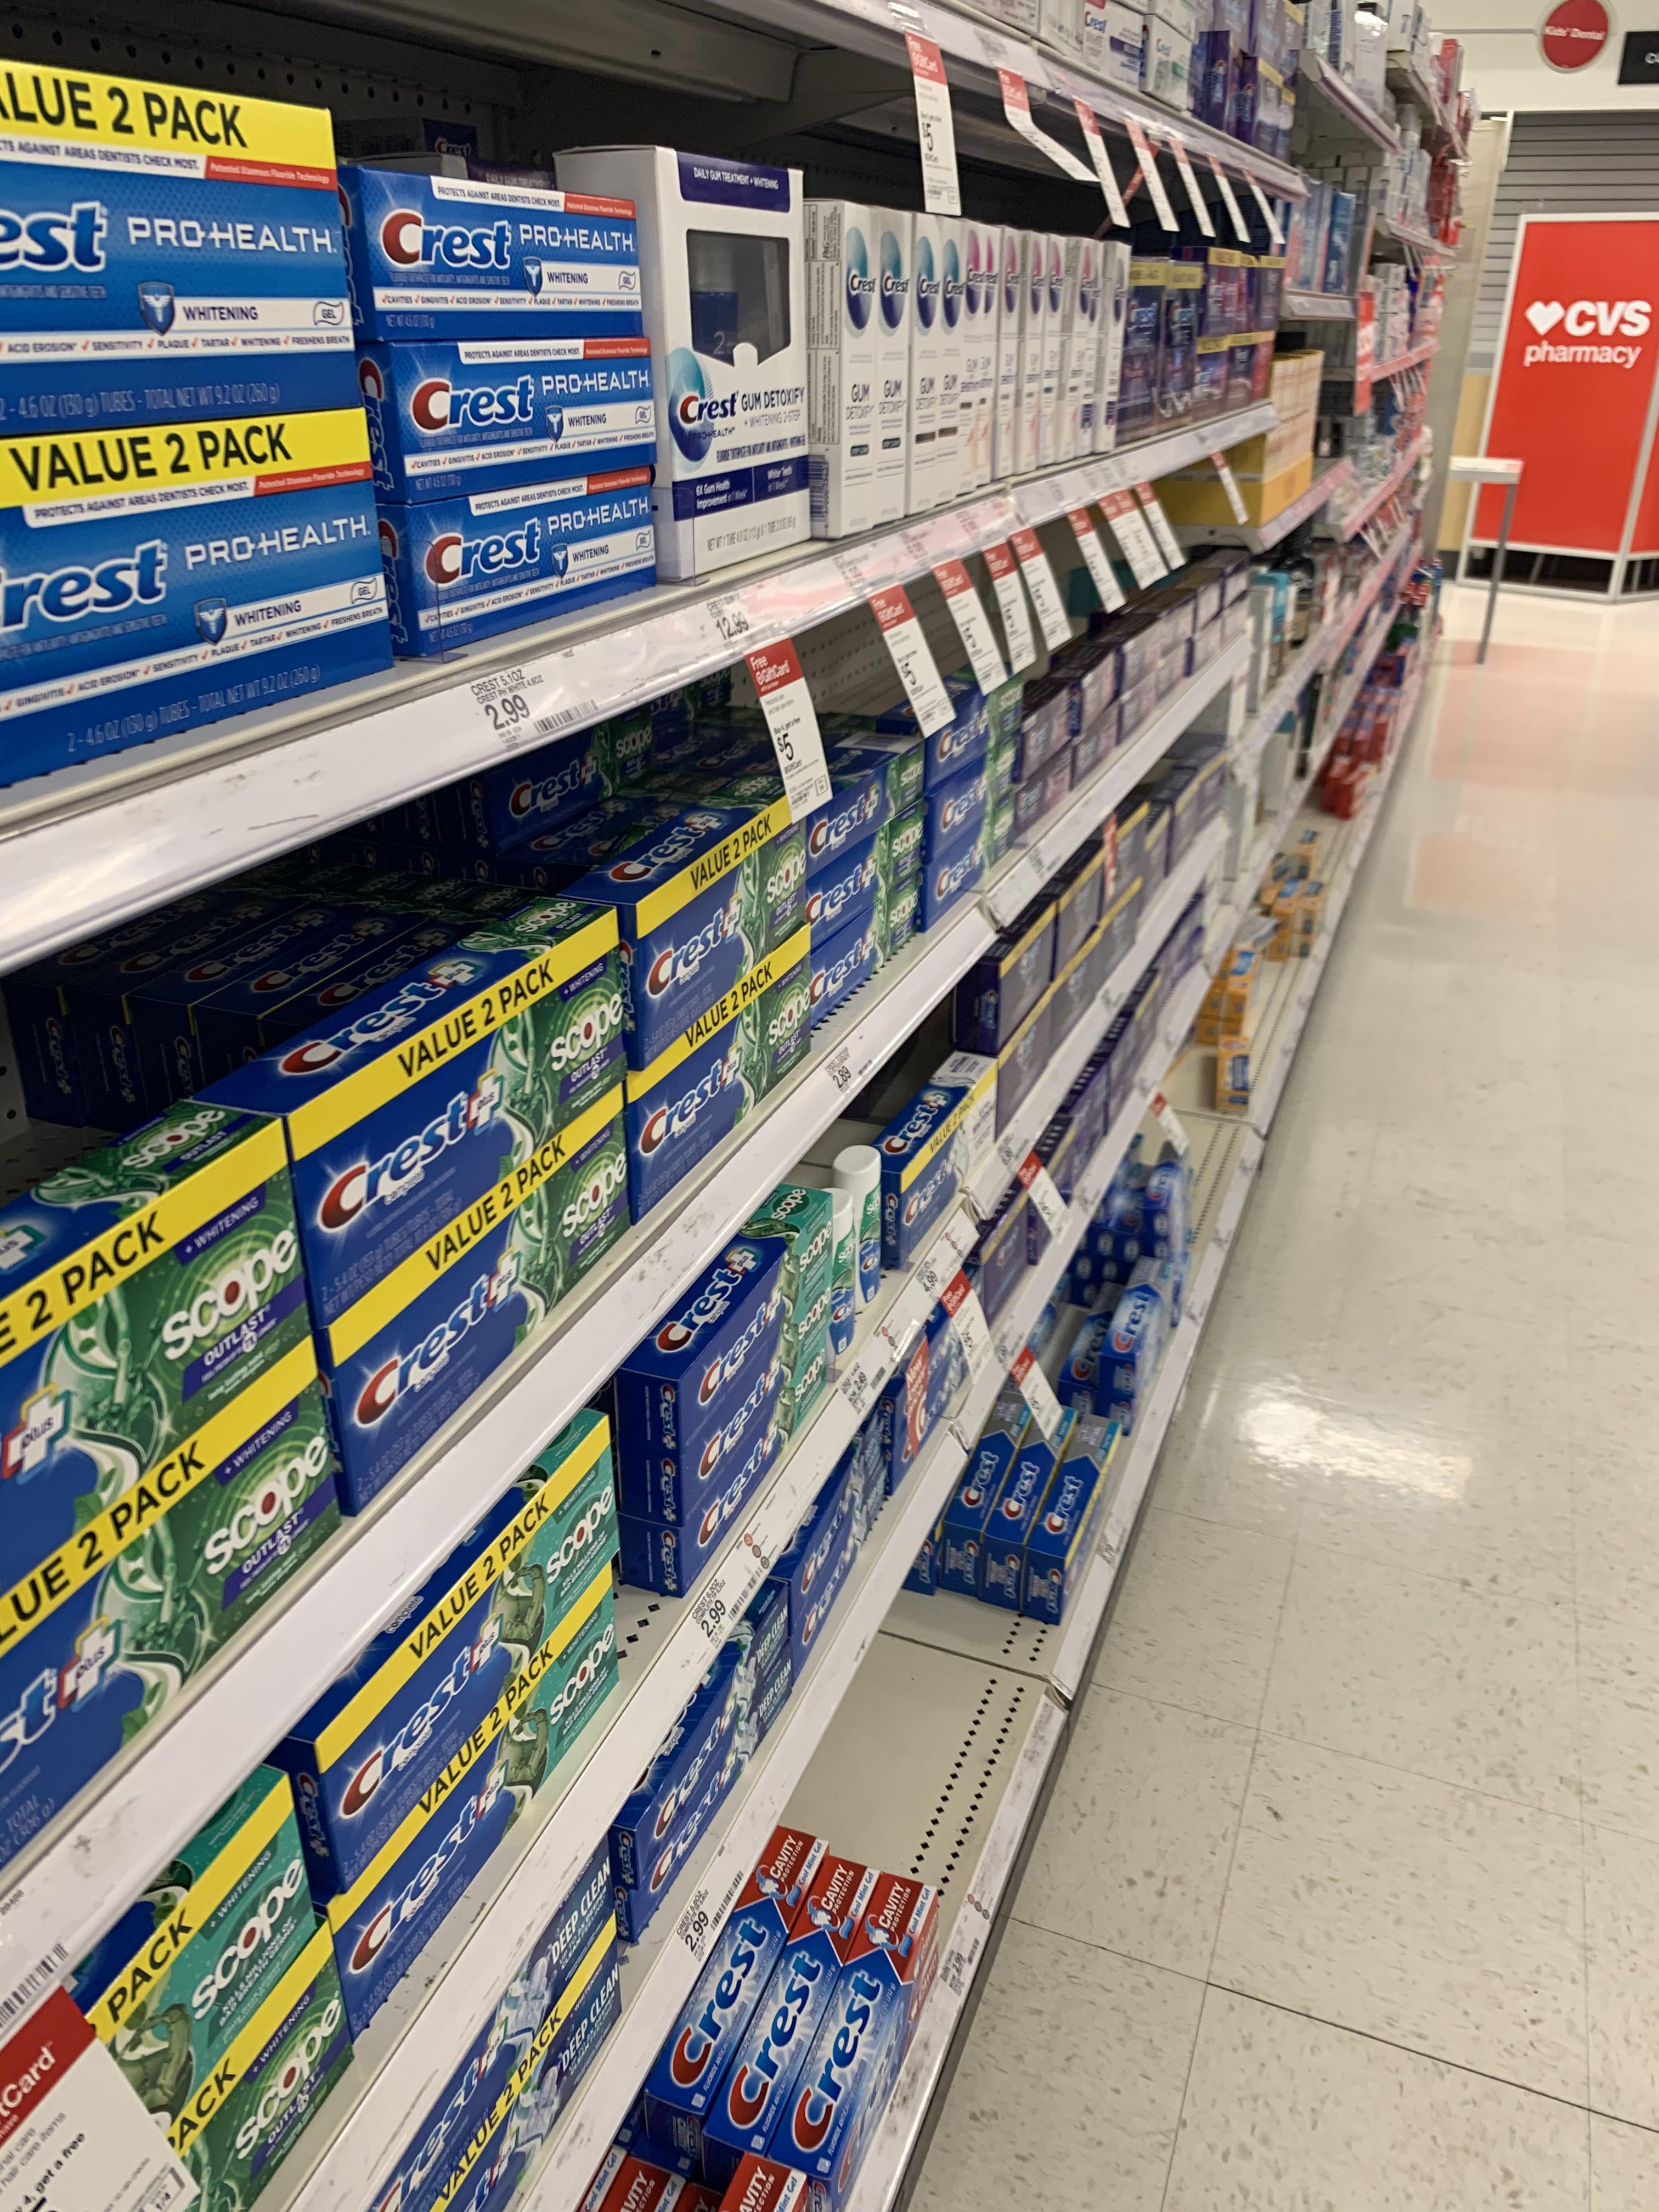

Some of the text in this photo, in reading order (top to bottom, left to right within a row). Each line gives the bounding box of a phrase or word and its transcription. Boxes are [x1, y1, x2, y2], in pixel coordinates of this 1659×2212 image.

[0, 72, 248, 148] LUE 2 PACK
[693, 167, 779, 190] DAILY GUM TREATMENT WHITENING
[382, 208, 511, 270] Crest
[547, 272, 588, 285] WHITENING
[850, 273, 875, 295] Crest
[884, 275, 909, 294] Crest
[183, 306, 258, 320] WHITENING
[1565, 300, 1651, 336] CVS
[1523, 340, 1642, 369] pharmacy
[411, 374, 534, 433] Crest
[568, 414, 606, 427] WHITENING
[680, 387, 804, 425] Crest GUM DETOXIFY
[749, 413, 782, 428] WHITENING
[10, 424, 291, 490] VALUE 2 PACK
[35, 503, 85, 518] PROTECTS
[86, 498, 125, 513] AGAINST
[128, 494, 156, 507] AREAS
[159, 489, 197, 503] DENTISTS
[199, 484, 226, 498] CHECK
[425, 517, 541, 588] Crest
[572, 545, 609, 562] WHITENING
[0, 539, 168, 633] rest
[234, 601, 301, 627] WHITENING
[716, 611, 749, 640] 12.99
[471, 678, 499, 696] CREST
[477, 692, 498, 704] CREST
[509, 682, 527, 696] WHITE
[484, 694, 531, 730] 2.99
[616, 726, 653, 758] scope
[777, 733, 794, 760] $5
[809, 790, 868, 856] Crest
[892, 822, 923, 857] scope
[610, 825, 705, 882] Crest
[690, 813, 771, 891] VALUE 2 PACK
[768, 848, 806, 904] scope
[516, 900, 576, 934] scope
[569, 963, 604, 992] WHITENING
[647, 907, 725, 999] Crest
[279, 980, 439, 1074] Crest
[398, 959, 554, 1077] VALUE 2 PACK
[550, 994, 623, 1070] scope
[685, 961, 773, 1048] VALUE 2 PACK
[769, 991, 810, 1045] scope
[571, 1051, 605, 1082] OUTLAST
[833, 1065, 851, 1088] 2.89
[639, 1057, 722, 1156] Crest
[884, 1105, 940, 1154] Crest
[123, 1109, 225, 1167] scope
[180, 1131, 227, 1161] OUTLAST
[317, 1091, 469, 1233] Crest
[193, 1197, 259, 1248] WHITENING
[425, 1136, 566, 1271] VALUE 2 PACK
[563, 1153, 625, 1238] scope
[771, 1189, 806, 1220] scope
[580, 1209, 612, 1245] OUTLAST
[799, 1221, 833, 1272] scope
[26, 1211, 165, 1331] 2 PACK
[162, 1229, 297, 1361] scope
[923, 1271, 938, 1293] 4.99
[203, 1306, 266, 1367] OUTLAST
[656, 1265, 743, 1353] Crest
[798, 1287, 831, 1340] scope
[354, 1274, 488, 1427] Crest
[698, 1302, 768, 1406] Crest
[795, 1349, 825, 1403] scope
[21, 1416, 54, 1449] plus
[234, 1412, 291, 1467] WHITENING
[698, 1372, 768, 1479] Crest
[78, 1441, 206, 1568] 2 PACK
[206, 1436, 325, 1575] scope
[698, 1439, 764, 1547] Crest
[963, 1451, 1000, 1508] Crest
[1003, 1461, 1041, 1520] Crest
[1046, 1475, 1084, 1534] Crest
[242, 1511, 300, 1574] OUTLAST
[546, 1486, 612, 1584] scope
[410, 1494, 549, 1660] VALUE 2 PACK
[692, 1596, 708, 1619] CREST
[701, 1600, 726, 1638] 2.99
[76, 1645, 105, 1680] plus
[550, 1623, 614, 1724] scope
[340, 1646, 474, 1819] Crest
[419, 1644, 554, 1814] VALUE 2 PACK
[218, 1852, 272, 1918] WHITENING
[350, 1795, 478, 1973] Crest
[771, 1835, 796, 1878] CAVITY
[780, 1840, 804, 1882] PROTECTION
[798, 1870, 809, 1884] Cool
[808, 1856, 817, 1872] Mint
[551, 1858, 611, 1966] DEEP CLEAN
[822, 1864, 848, 1911] CAVITY
[832, 1870, 855, 1914] PROTECTION
[879, 1882, 905, 1929] CAVITY
[890, 1888, 912, 1933] PROTECTION
[192, 1858, 302, 2019] scope
[685, 1911, 709, 1952] 2.99
[106, 1908, 193, 2023] PACK
[260, 1994, 311, 2063] WHITENING
[562, 1963, 619, 2072] DEEP CLEAN
[671, 1918, 769, 2087] Crest
[729, 1950, 823, 2129] Crest
[792, 1970, 884, 2152] Crest
[236, 1999, 340, 2160] scope
[440, 2007, 561, 2201] VALUE PACK
